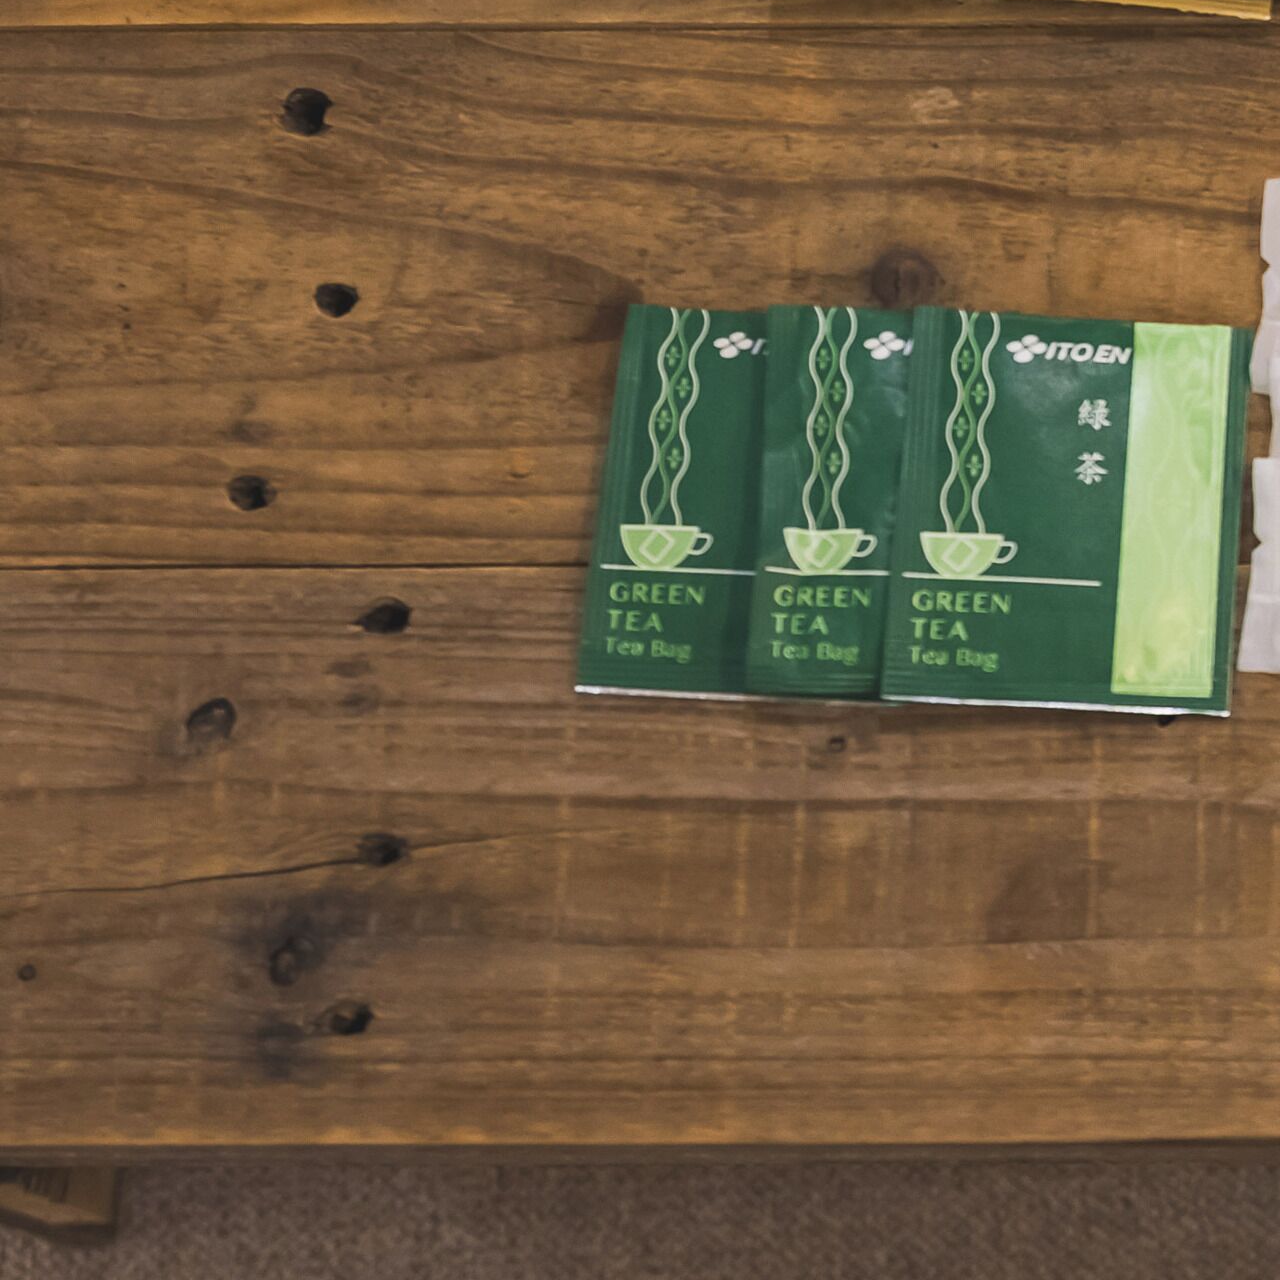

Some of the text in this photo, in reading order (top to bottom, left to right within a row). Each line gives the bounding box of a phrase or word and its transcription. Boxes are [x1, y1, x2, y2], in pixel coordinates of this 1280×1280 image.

[609, 581, 706, 605] GREEN
[773, 584, 872, 608] GREEN
[911, 588, 1013, 614] GREEN
[607, 609, 665, 632] TEA
[771, 612, 829, 635] TEA
[910, 617, 969, 641] TEA
[605, 636, 693, 664] Tea Bag
[770, 639, 860, 666] Tea Bag
[908, 645, 1000, 673] Tea Bag
